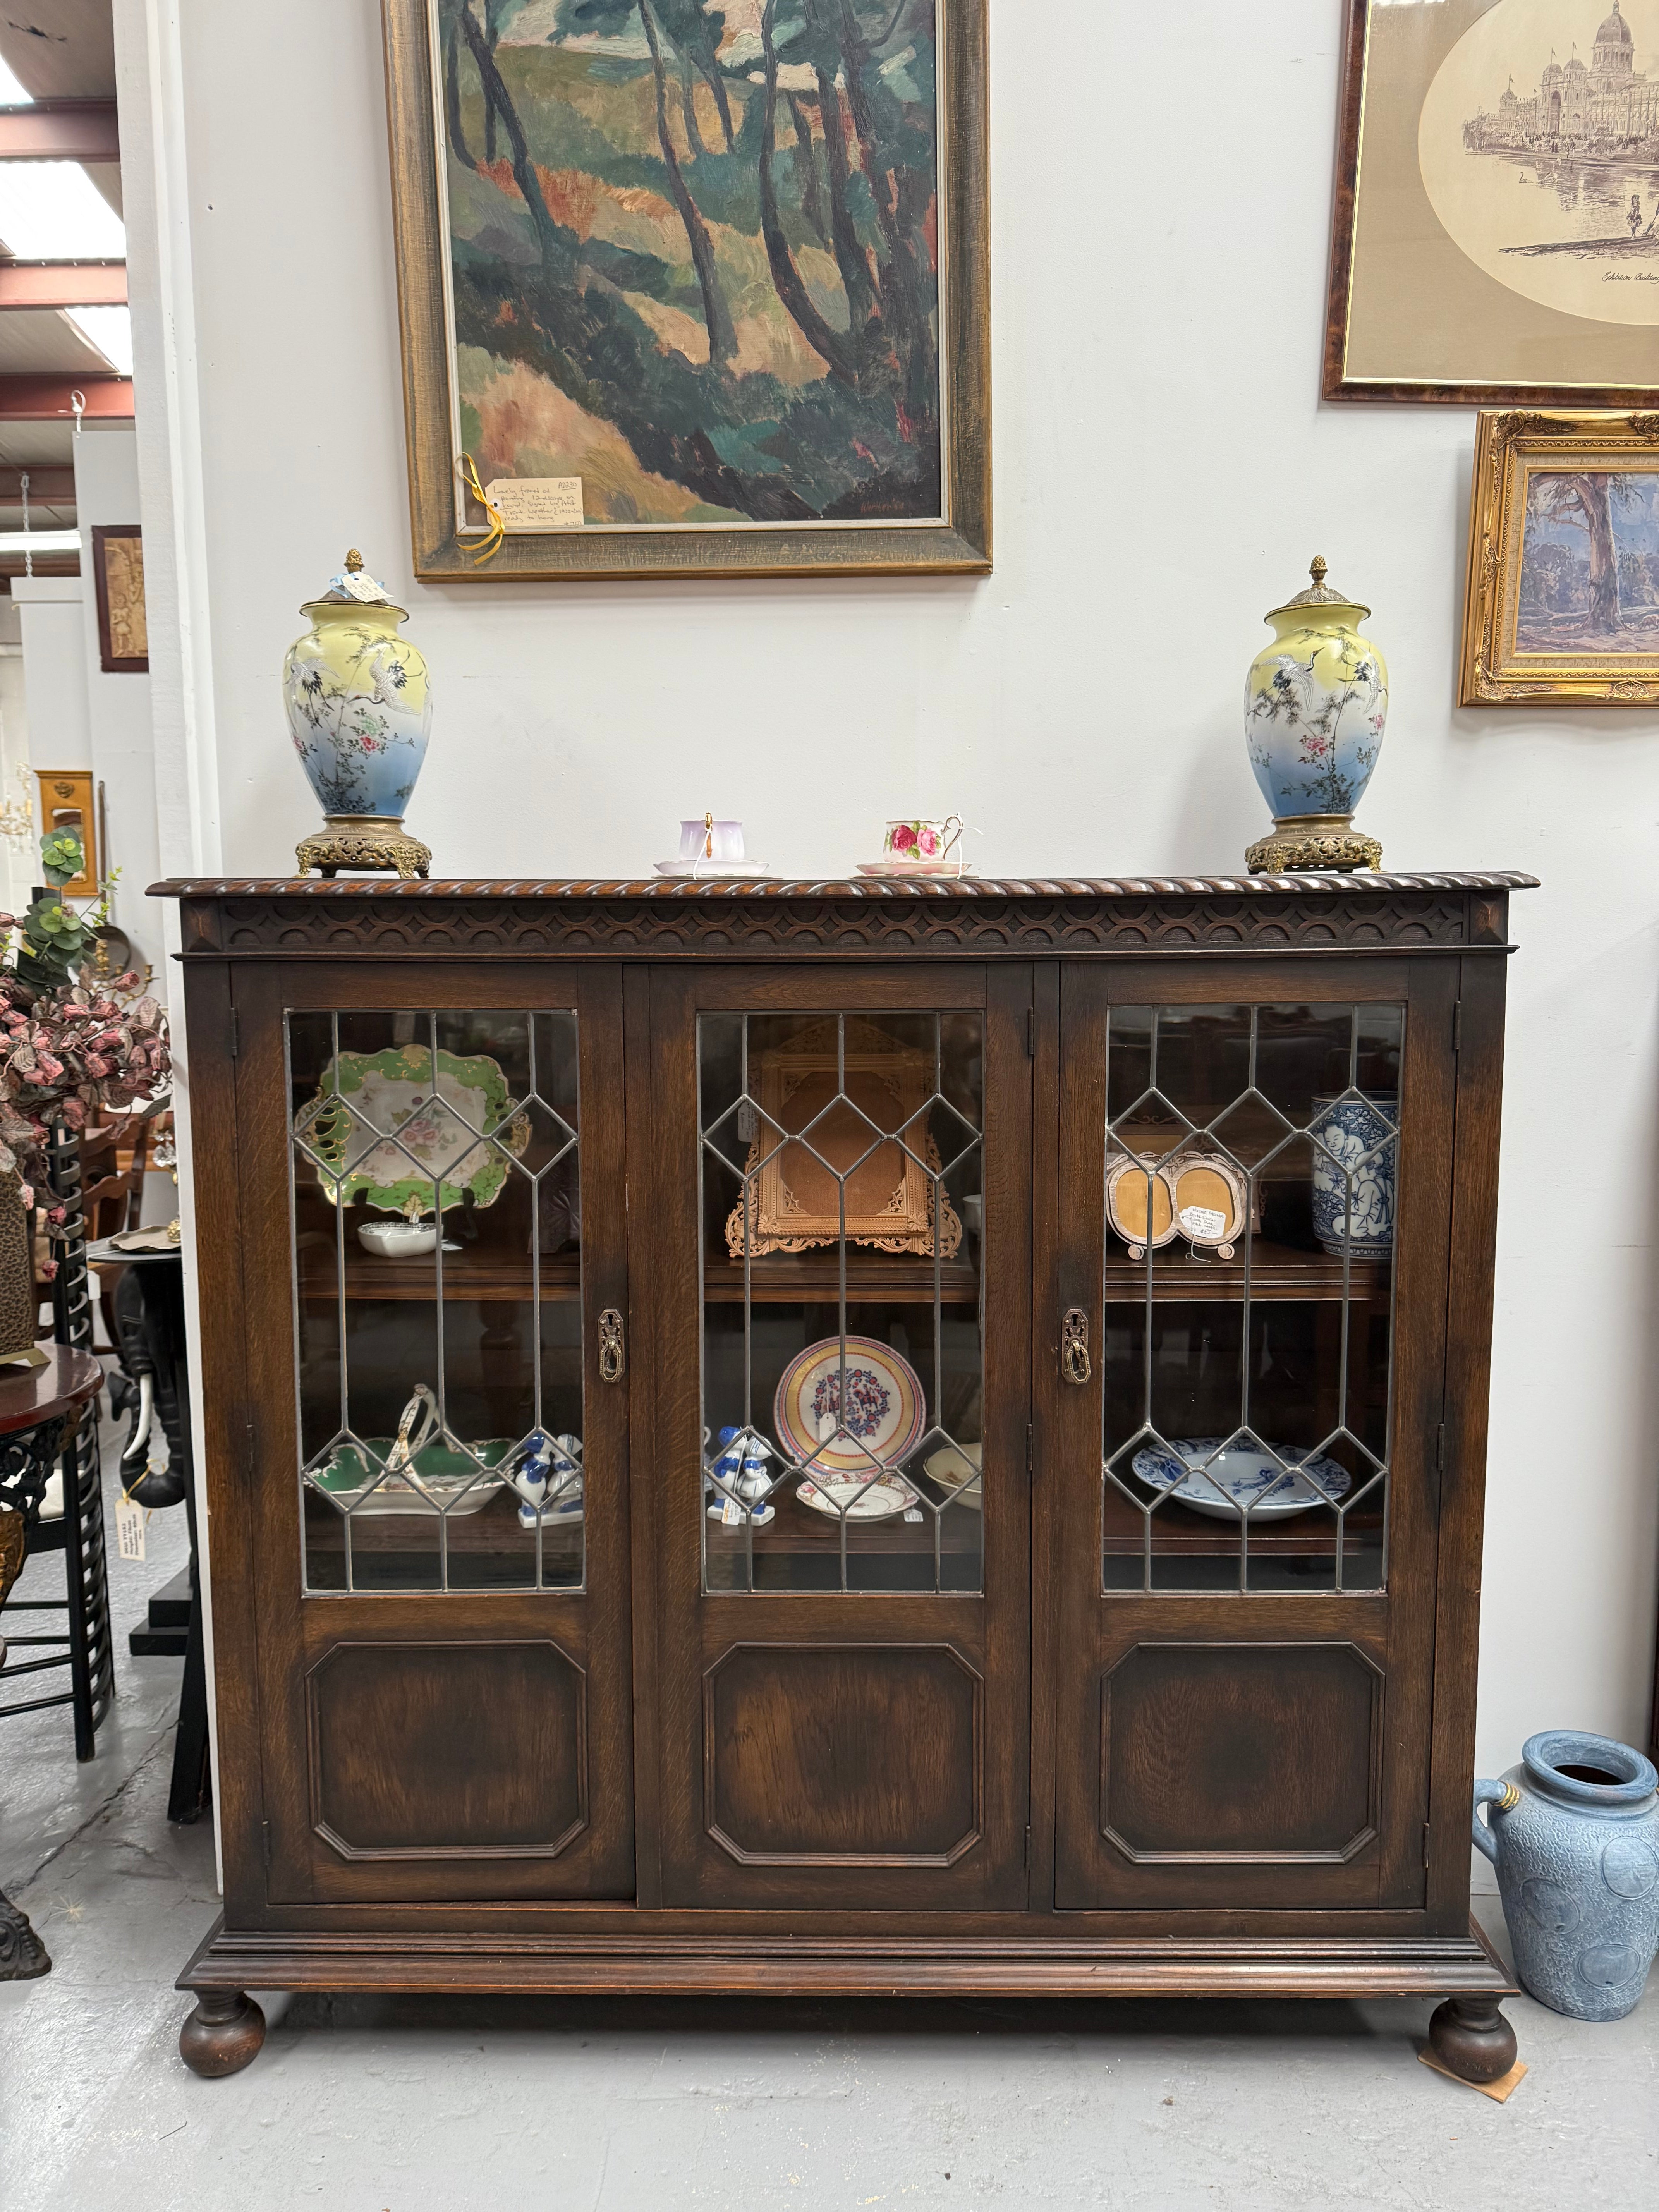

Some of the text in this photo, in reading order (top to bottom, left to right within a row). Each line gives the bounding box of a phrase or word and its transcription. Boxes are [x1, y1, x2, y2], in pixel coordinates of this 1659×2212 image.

[493, 486, 517, 497] Lovely
[504, 515, 524, 523] ready
[538, 515, 555, 523] hang
